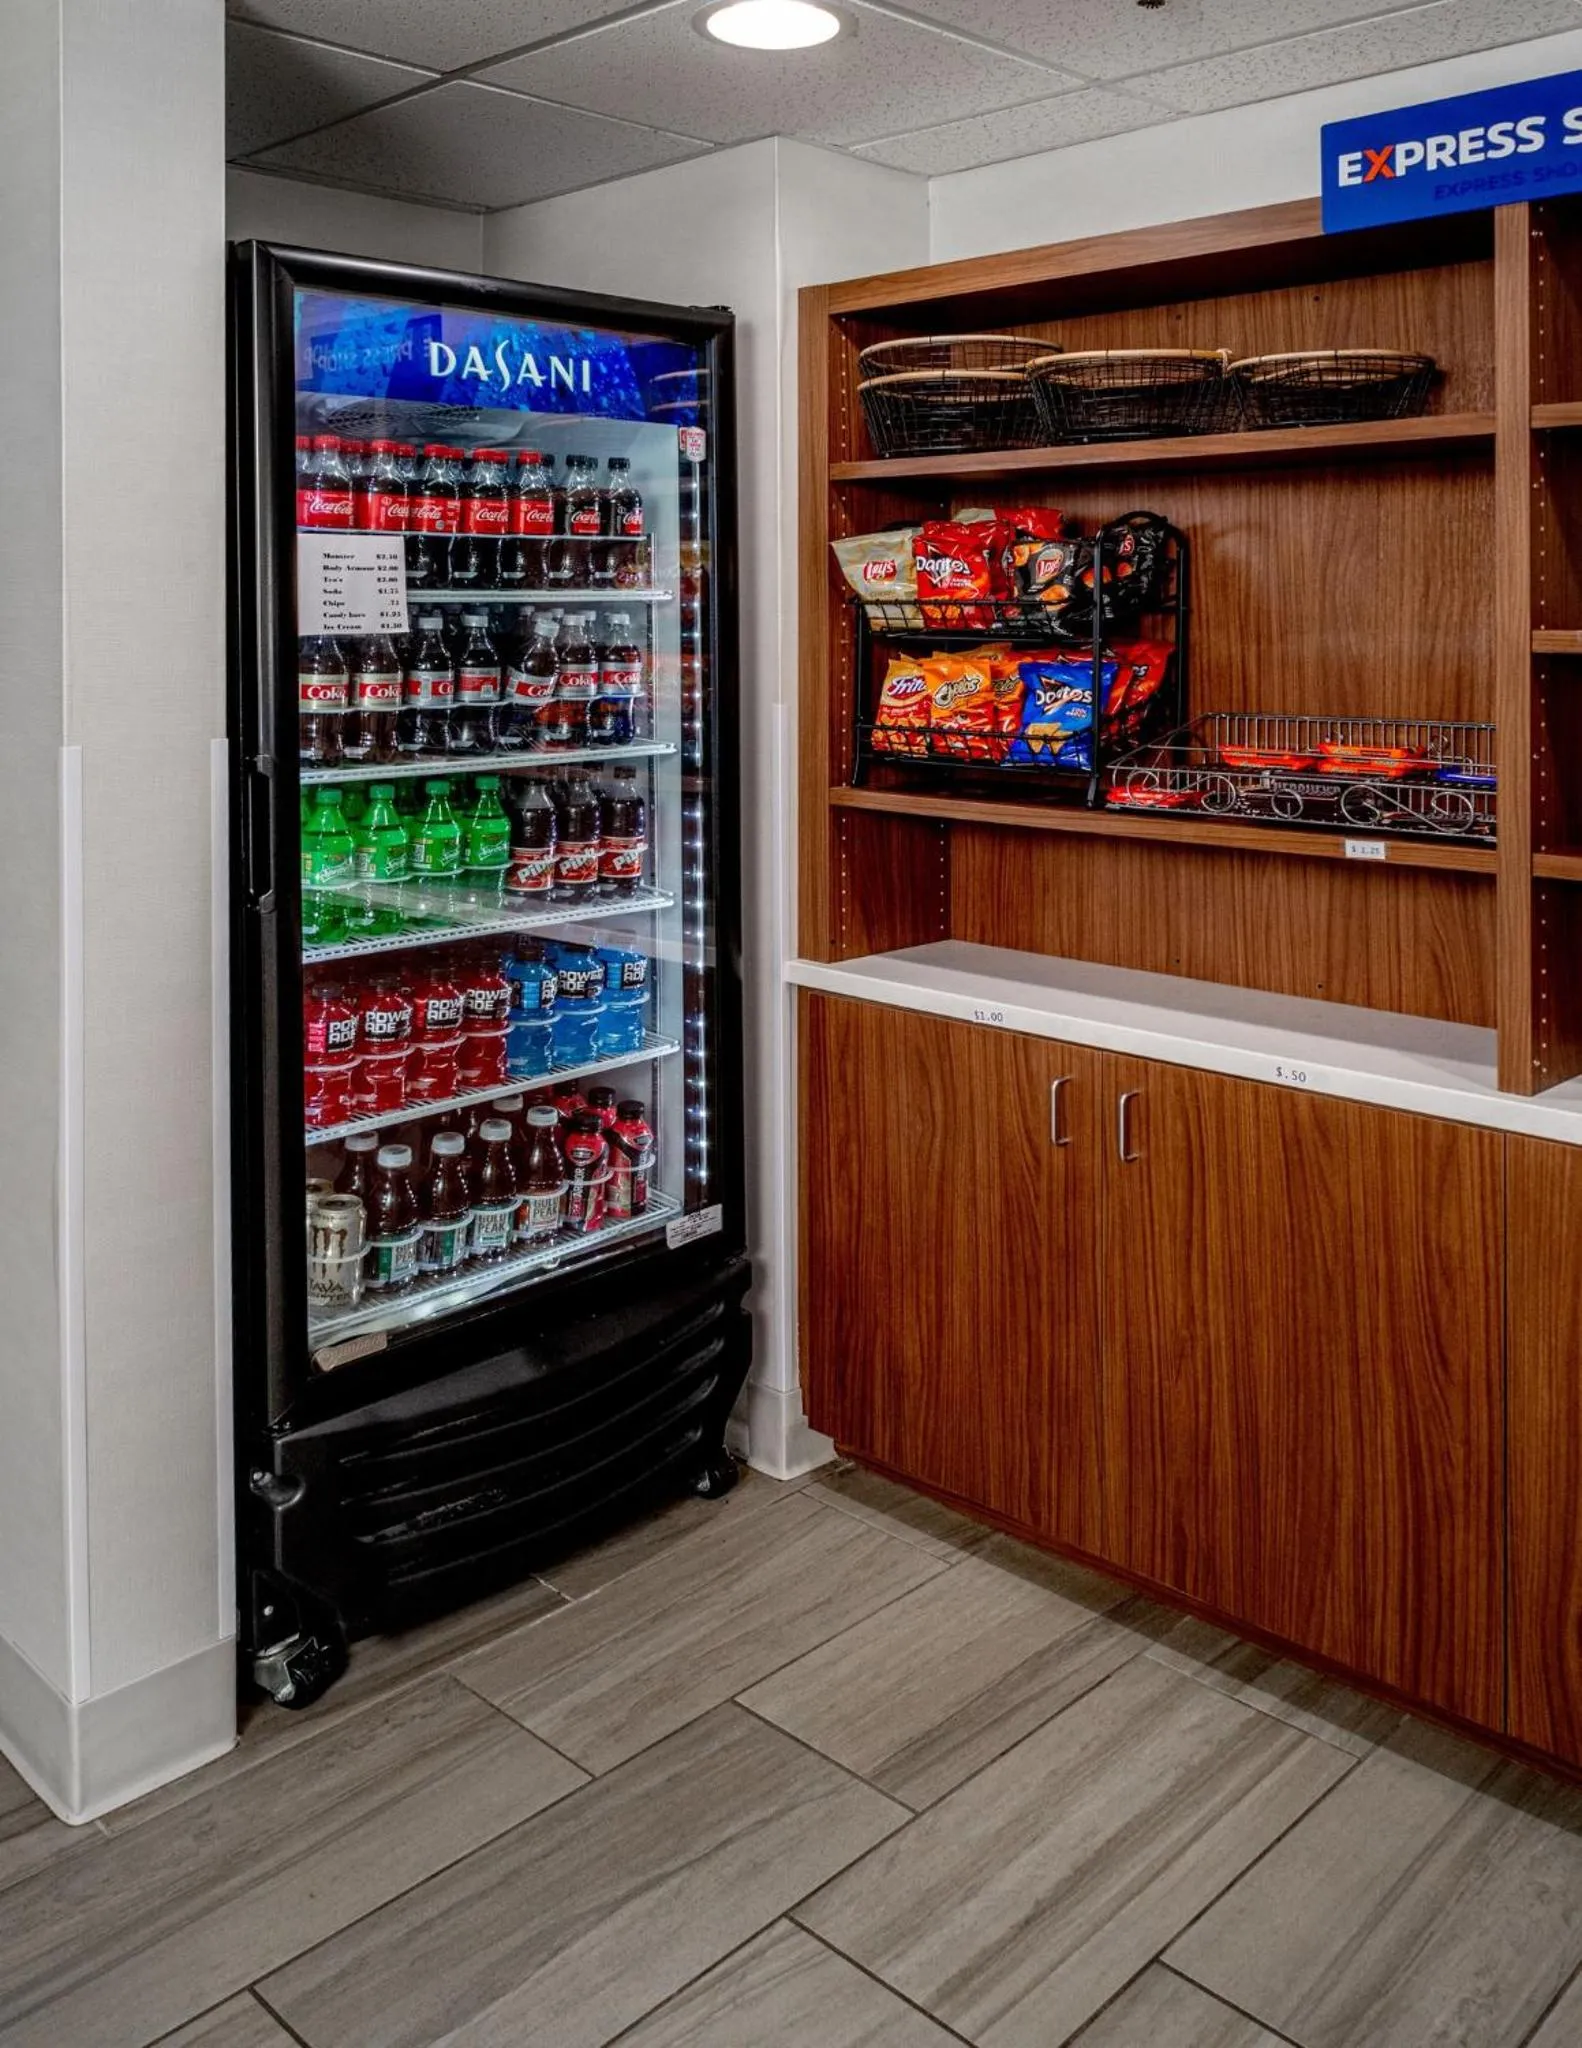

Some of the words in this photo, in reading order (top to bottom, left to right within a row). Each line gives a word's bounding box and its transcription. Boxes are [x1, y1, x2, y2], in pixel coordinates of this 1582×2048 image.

[1338, 116, 1546, 187] EXPRESS
[1434, 169, 1525, 200] EXPRESS
[429, 339, 590, 392] DASANI
[916, 556, 971, 575] Doritos
[307, 685, 346, 699] Coke
[365, 684, 402, 698] Coke
[1036, 685, 1093, 706] Doritos
[364, 1022, 397, 1034] ADE
